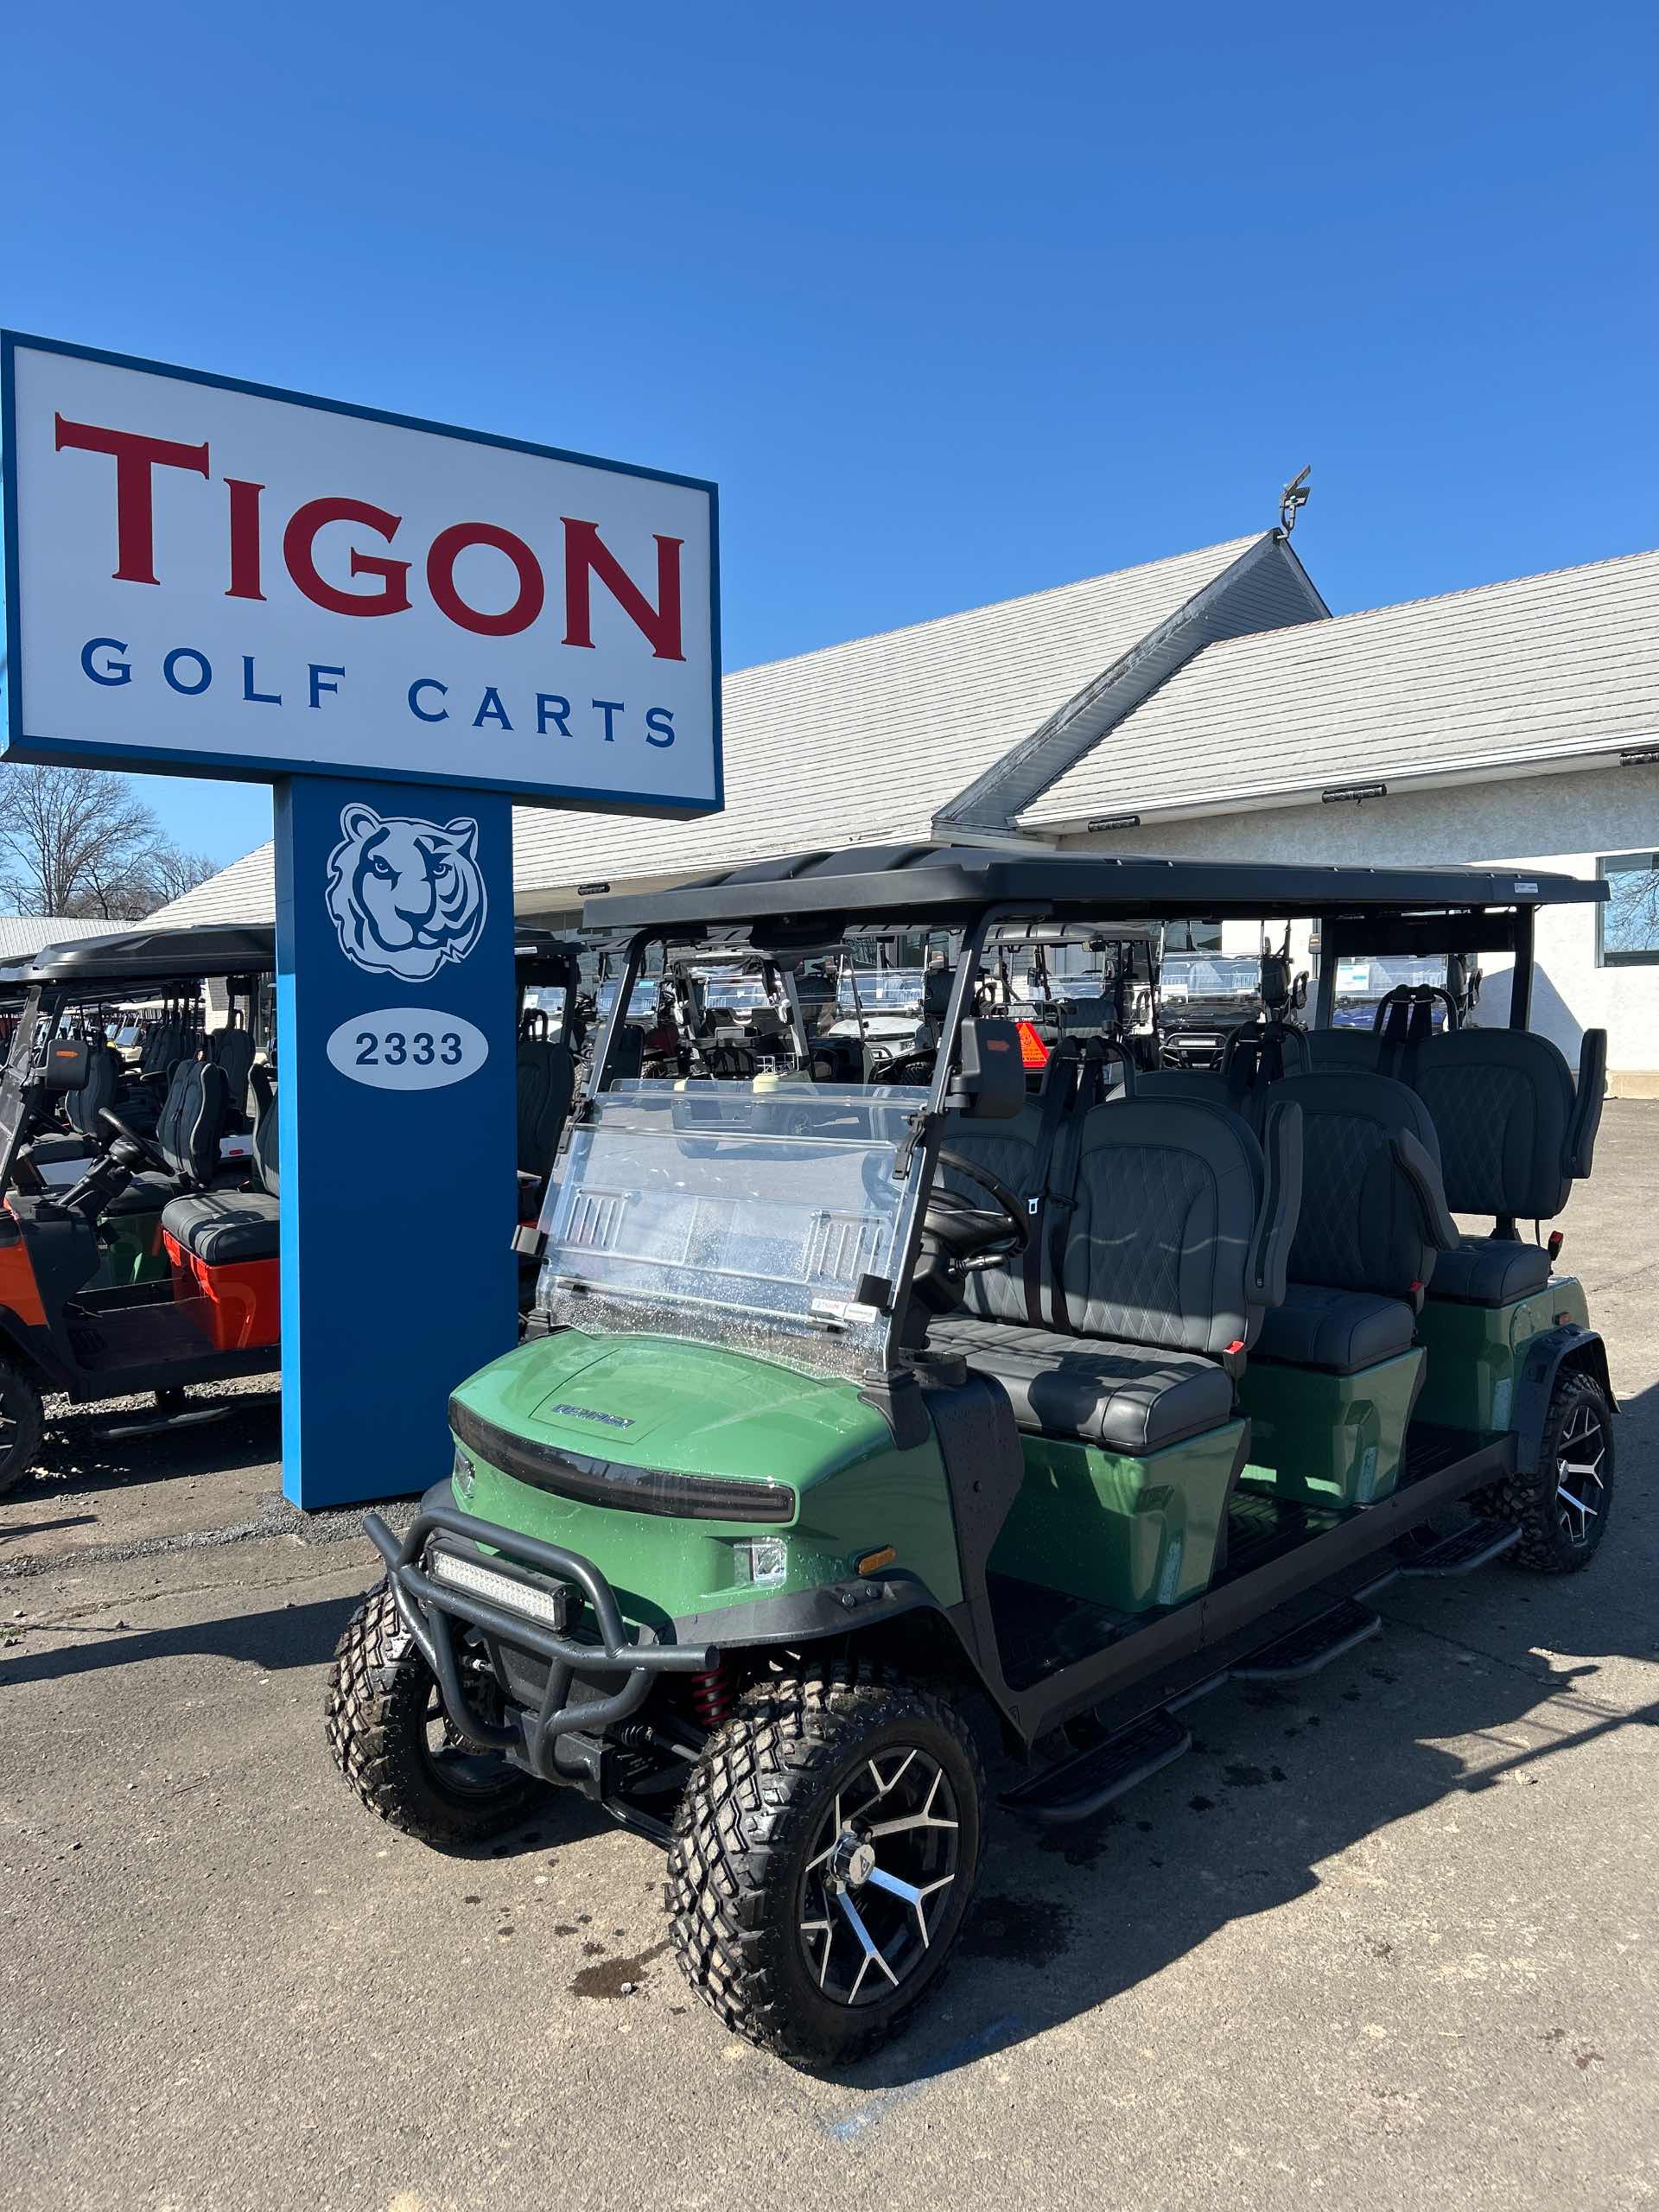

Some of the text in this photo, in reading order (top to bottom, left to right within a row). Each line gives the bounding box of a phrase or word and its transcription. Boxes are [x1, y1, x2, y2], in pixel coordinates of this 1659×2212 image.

[55, 411, 686, 662] TIGON
[80, 637, 677, 748] GOLF CARTS
[355, 1032, 463, 1065] 2333
